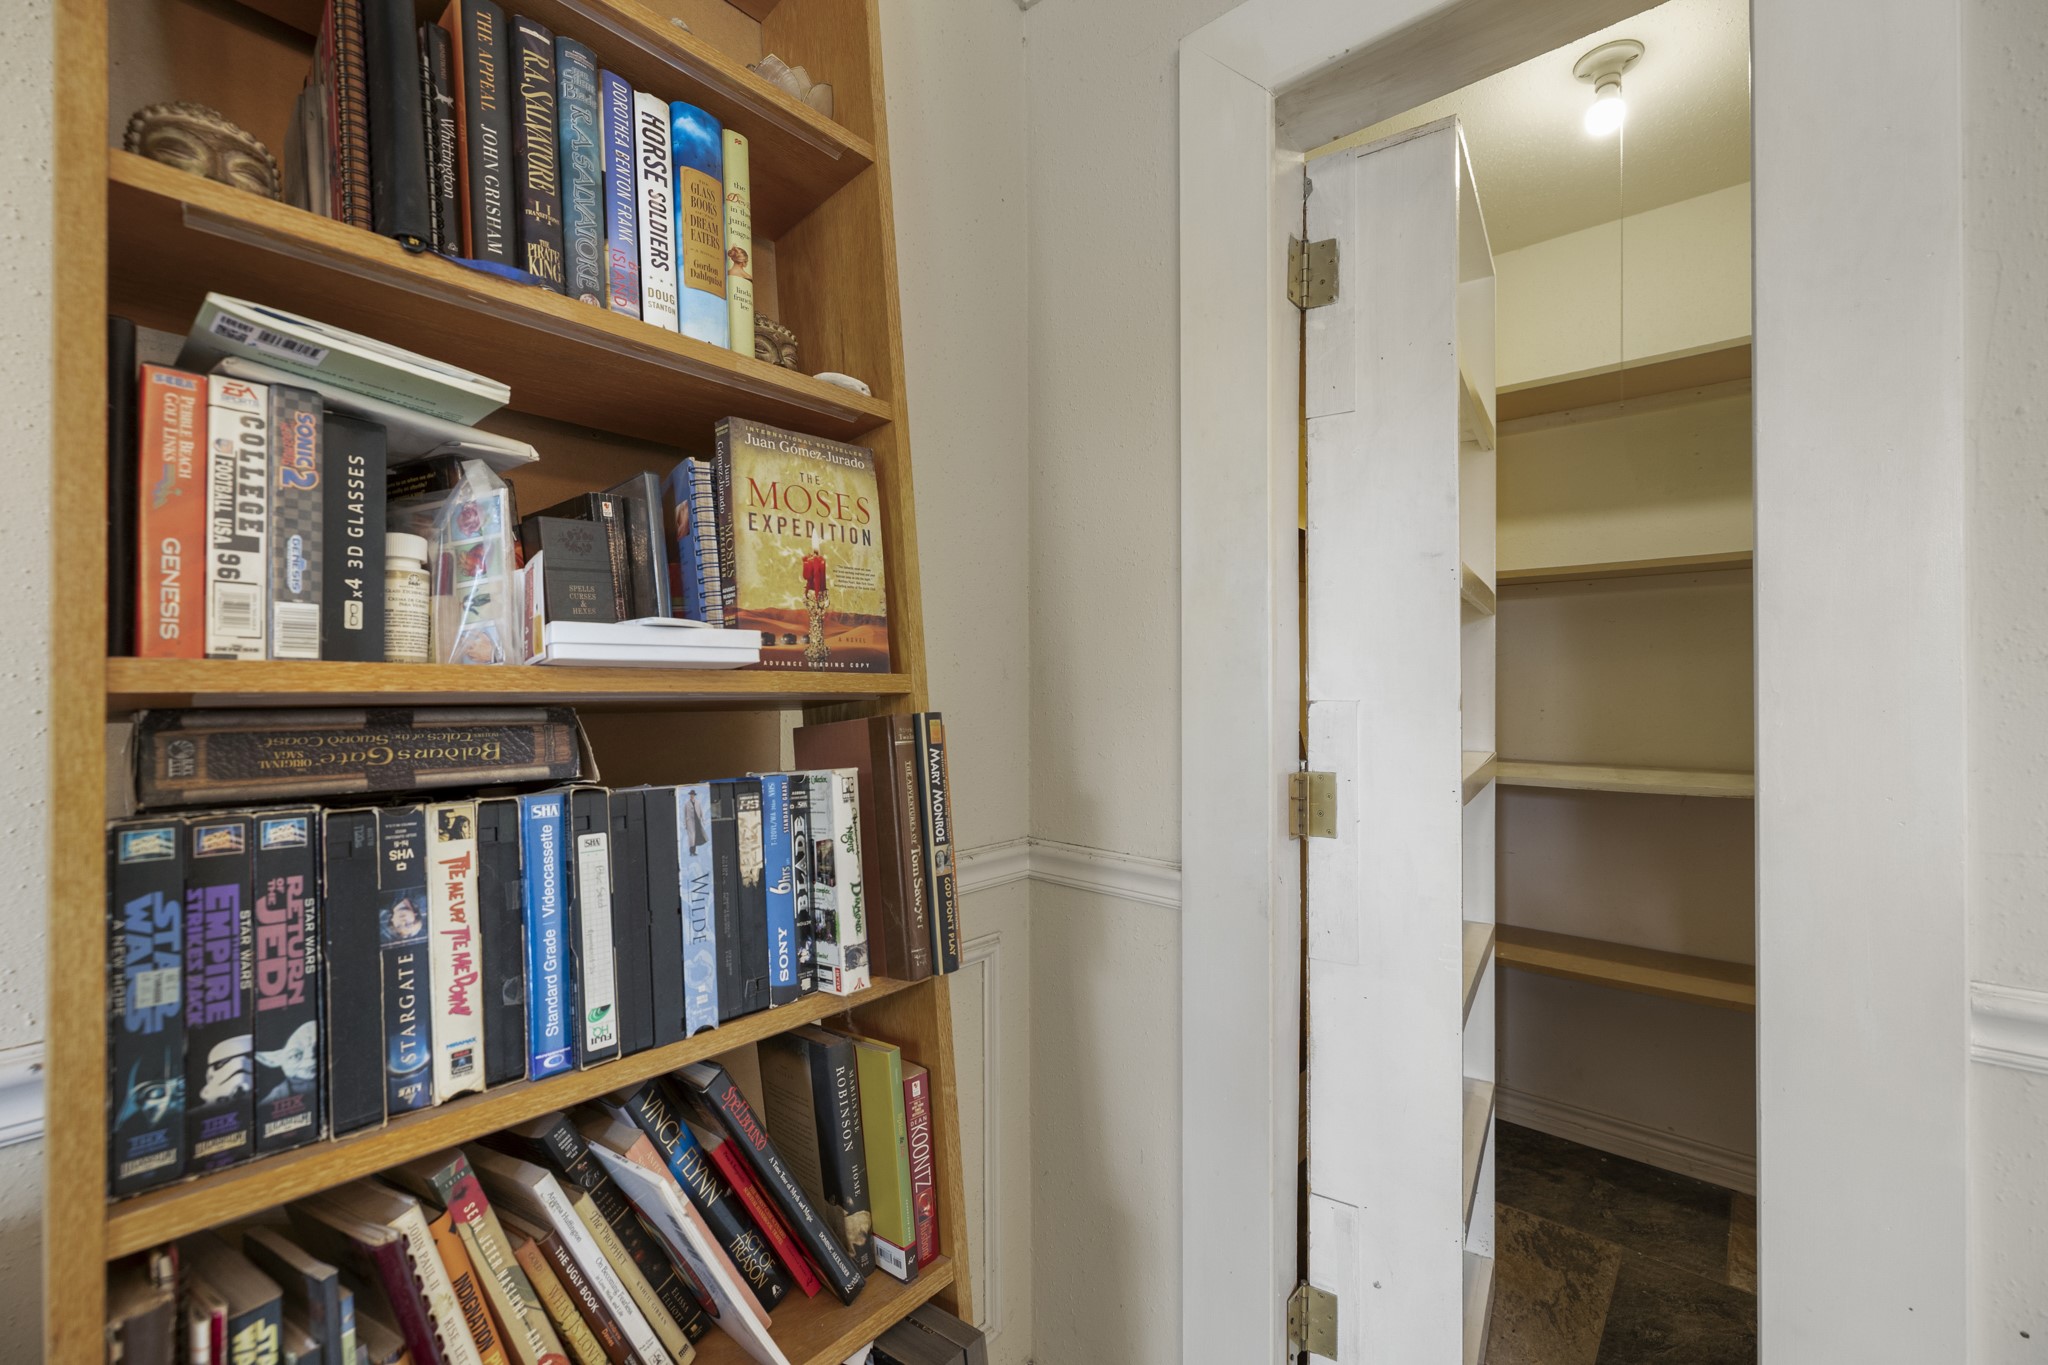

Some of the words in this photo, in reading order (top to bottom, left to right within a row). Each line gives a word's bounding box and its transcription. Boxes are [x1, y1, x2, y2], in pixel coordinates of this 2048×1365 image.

[477, 11, 493, 45] THE
[479, 47, 496, 111] APPEAL
[612, 81, 630, 148] DOROTHEA
[481, 123, 499, 172] JOHN
[521, 83, 555, 196] SALVATORE
[641, 111, 668, 188] HORSE
[438, 118, 456, 199] Whittington
[614, 149, 631, 202] BENTON
[690, 196, 718, 217] BOOKS
[691, 182, 715, 202] GLASS
[485, 175, 503, 255] GRISHAM
[572, 152, 600, 291] SALVATORE
[617, 201, 634, 246] FRANK
[648, 189, 669, 271] SOLDIERS
[690, 214, 719, 237] DREAM
[691, 229, 720, 250] EATERS
[529, 256, 561, 284] KING
[612, 248, 628, 307] ISLAND
[690, 267, 723, 288] Dahlquist
[693, 259, 719, 276] Gordon
[648, 287, 675, 305] DOUG
[648, 301, 676, 315] STANTON
[153, 372, 197, 392] SEGA
[163, 392, 178, 425] GOLF
[163, 427, 178, 462] LINKS
[295, 411, 317, 470] SONIC
[744, 433, 776, 450] Juan
[779, 440, 865, 470] Gómez-Jurado
[745, 426, 812, 446] INTERNATIONAL
[816, 442, 862, 457] BESTSELLER
[178, 440, 194, 479] BEACH
[238, 415, 266, 533] COLLEGE
[214, 459, 234, 515] FOOTBALL
[280, 466, 320, 490] 2
[800, 472, 820, 486] THE
[347, 455, 365, 538] GLASSES
[746, 477, 871, 525] MOSES
[214, 517, 233, 544] USA
[748, 512, 871, 546] EXPEDITION
[217, 553, 241, 580] 96
[347, 546, 364, 569] 3D
[725, 524, 735, 578] MOSES
[159, 537, 181, 640] GENESIS
[344, 578, 363, 598] x4
[569, 585, 596, 593] SPELLS
[580, 600, 587, 608] &
[572, 607, 597, 615] HEXES
[326, 735, 389, 747] Sword
[427, 732, 474, 743] Tales
[260, 759, 312, 769] ORIGINAL
[273, 751, 304, 760] SAGA
[319, 747, 393, 766] Gate
[929, 748, 941, 785] MARY
[531, 804, 559, 819] VHS
[906, 779, 916, 831] ADVENTURES
[932, 789, 946, 843] MONROE
[388, 848, 414, 861] VHS
[584, 838, 600, 848] VHS
[911, 844, 921, 877] Tom
[438, 851, 471, 880] TIE
[542, 824, 555, 918] Videocassette
[769, 866, 791, 895] 6hrs
[794, 815, 809, 914] BLADE
[267, 879, 277, 905] THE
[276, 878, 286, 894] OF
[445, 882, 464, 901] ME
[914, 876, 924, 930] Sawyer
[944, 876, 952, 898] GOD
[305, 898, 315, 931] STAR
[691, 873, 709, 945] WILDE
[850, 881, 861, 936] DIAMOND
[946, 900, 954, 931] DON'T
[239, 910, 251, 945] STAR
[286, 875, 305, 1006] RETURN
[440, 925, 470, 951] TIE
[948, 933, 957, 956] PLAY
[112, 935, 126, 969] NEW
[204, 884, 241, 1024] EMPIRE
[255, 897, 288, 1012] JEDI
[305, 936, 316, 974] WARS
[451, 952, 472, 975] ME
[543, 929, 557, 972] Grade
[778, 927, 789, 982] SONY
[240, 949, 251, 990] WARS
[399, 953, 416, 1065] STARGATE
[545, 976, 559, 1037] Standard
[591, 1033, 612, 1045] FUJI
[835, 1066, 854, 1152] ROBINSON
[849, 1069, 860, 1133] MARILYNNE
[910, 1115, 928, 1127] DEAN
[639, 1089, 687, 1155] VINCE
[676, 1148, 724, 1208] FLYNN
[910, 1122, 932, 1194] KOONTZ
[772, 1161, 781, 1175] Time
[780, 1171, 789, 1185] Tour
[790, 1187, 801, 1203] Myth
[852, 1164, 862, 1197] HOME
[408, 1222, 426, 1251] JOHN
[420, 1251, 437, 1276] PAUL
[463, 1202, 486, 1233] SENA
[479, 1233, 503, 1271] JETER
[589, 1210, 601, 1230] The
[599, 1227, 628, 1267] PROPHET
[741, 1229, 765, 1259] ACT
[759, 1251, 776, 1272] OF
[594, 1256, 606, 1268] On
[729, 1233, 769, 1289] TREASON
[554, 1246, 569, 1266] THE
[566, 1263, 584, 1288] UGLY
[580, 1285, 600, 1313] BOOK
[598, 1265, 623, 1296] Becoming
[452, 1272, 495, 1354] INDIGNATION
[616, 1292, 636, 1316] Fearless
[661, 1294, 684, 1323] ELLIOTT
[671, 1287, 690, 1313] ELISSA
[548, 1284, 574, 1325] WHAT
[577, 1333, 602, 1365] LOVE
